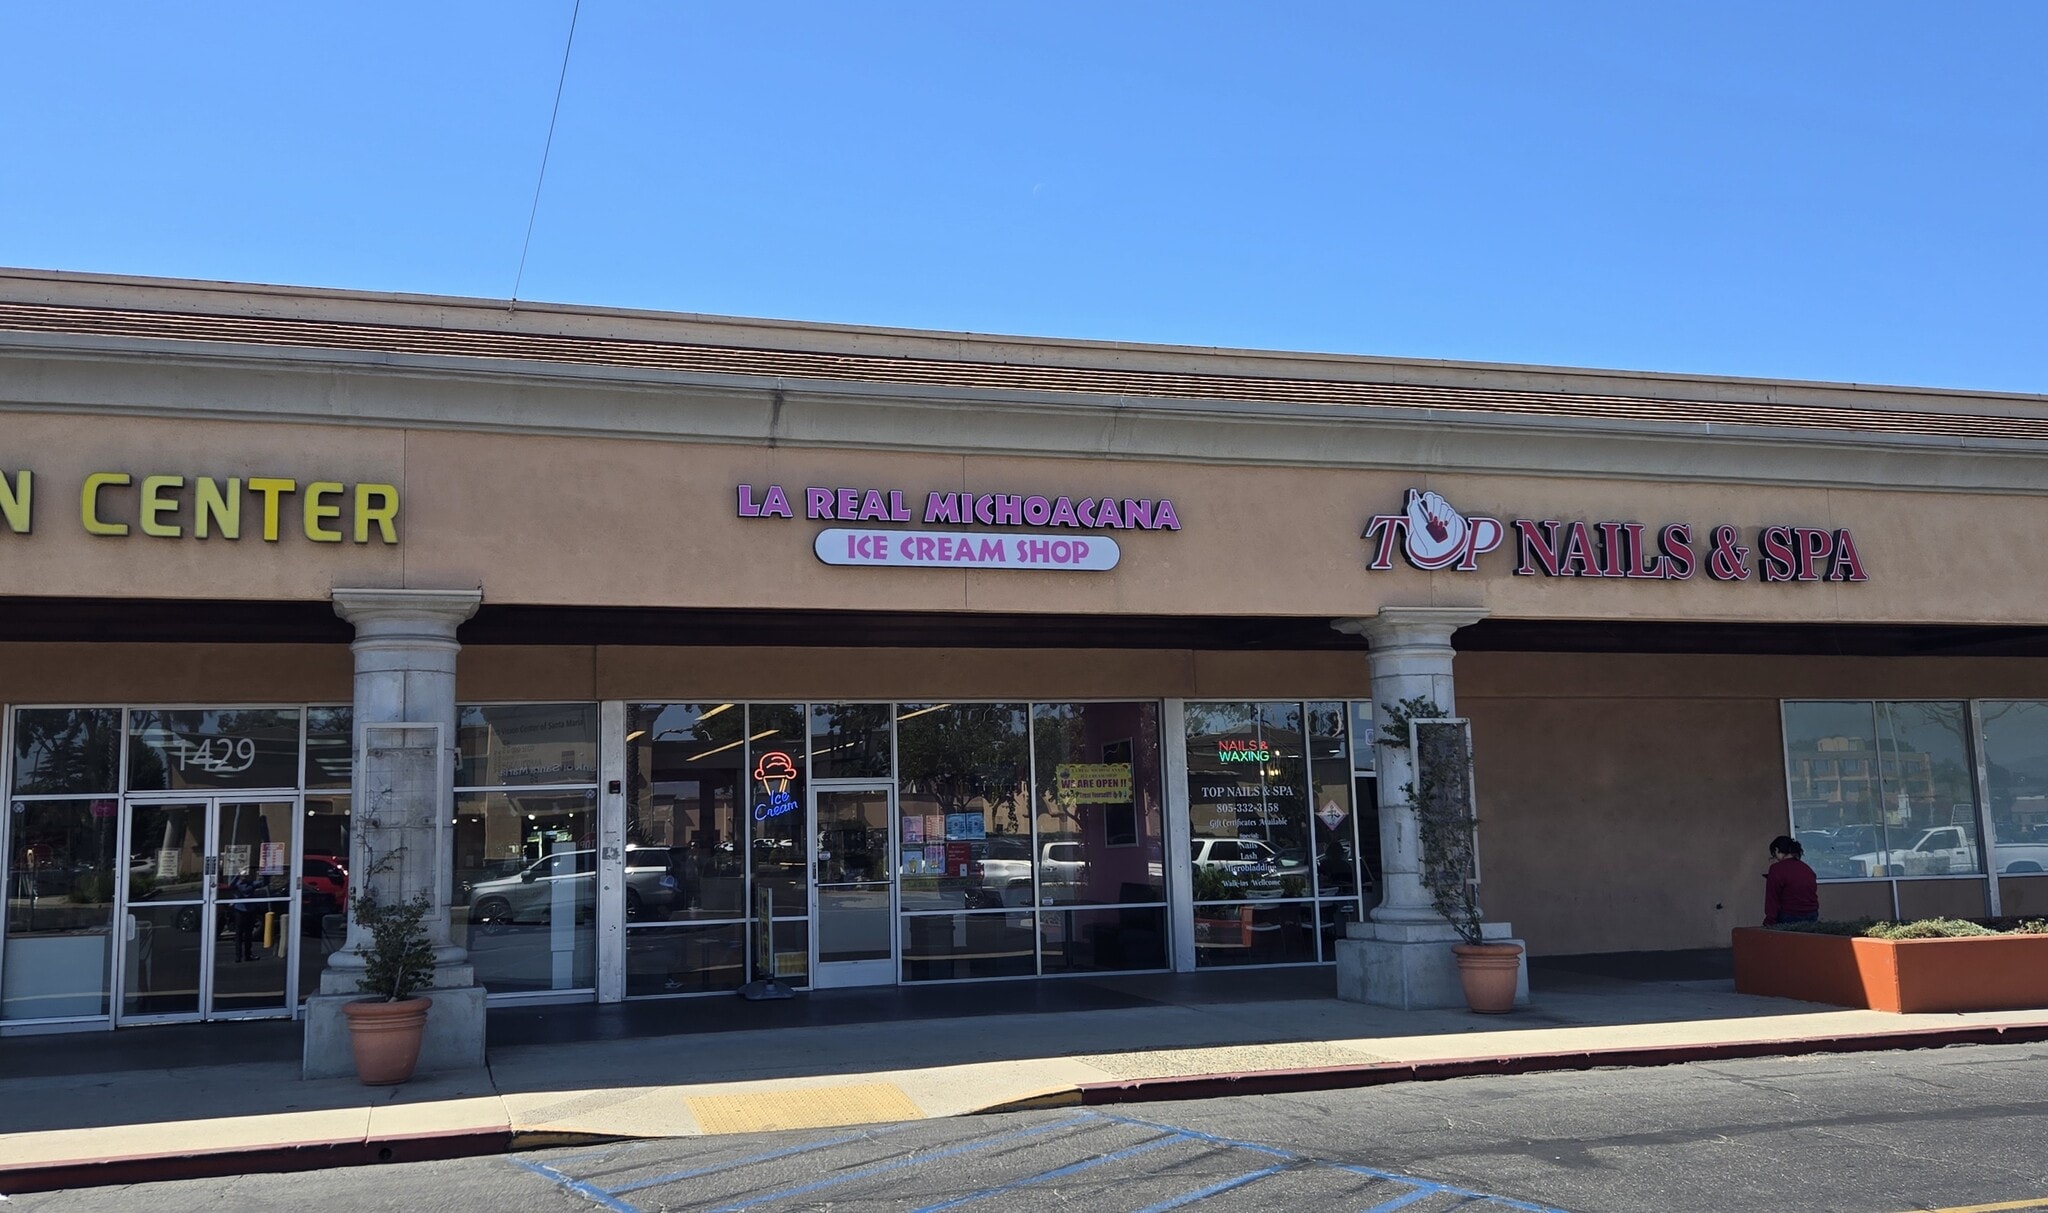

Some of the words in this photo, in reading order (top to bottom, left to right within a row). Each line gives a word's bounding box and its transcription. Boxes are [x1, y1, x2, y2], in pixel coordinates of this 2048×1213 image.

[80, 472, 400, 544] CENTER
[736, 483, 794, 519] LA
[805, 486, 912, 524] REAL
[922, 491, 1182, 531] MICHOACANA
[1360, 498, 1503, 572] TOP
[1512, 517, 1698, 580] NAILS
[1704, 523, 1752, 582] &
[1757, 524, 1869, 582] SPA
[847, 534, 888, 560] ICE
[899, 535, 1007, 563] CREAM
[1016, 539, 1090, 564] SHOP
[1218, 740, 1258, 751] NAILS
[1260, 740, 1269, 750] &
[180, 738, 256, 772] 1429
[1218, 751, 1270, 762] WAXING
[1061, 779, 1076, 789] WE
[1077, 779, 1095, 788] ARE
[1096, 778, 1119, 788] OPEN
[770, 790, 789, 805] Ice
[1202, 786, 1225, 797] TOP
[1227, 786, 1260, 797] NAILS
[1262, 786, 1271, 796] &
[1272, 785, 1294, 796] SPA
[754, 801, 799, 821] Cream
[1216, 803, 1280, 813] 805-332-3158
[1209, 819, 1222, 829] Gift
[1222, 818, 1257, 829] Certificates
[1258, 816, 1288, 827] Available
[1238, 842, 1258, 850] Nails
[1240, 852, 1258, 860] Lash
